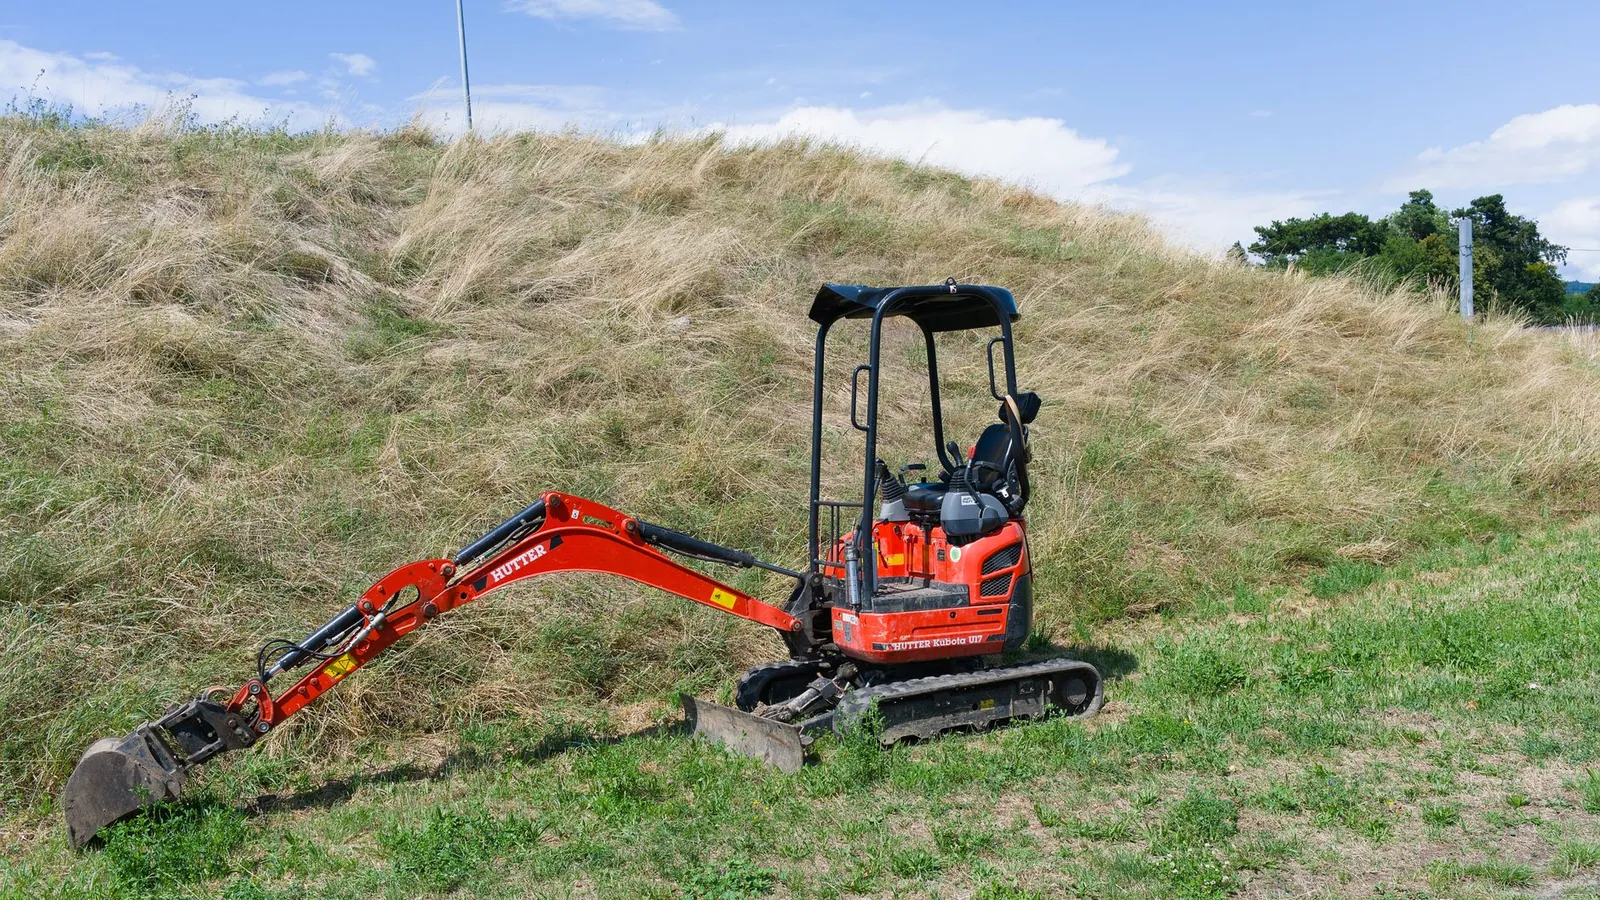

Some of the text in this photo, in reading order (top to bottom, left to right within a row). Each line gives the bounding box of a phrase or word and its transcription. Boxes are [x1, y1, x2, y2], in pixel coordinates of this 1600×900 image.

[490, 544, 547, 582] HUTTER
[893, 635, 983, 651] HUTTER Kubota U17
